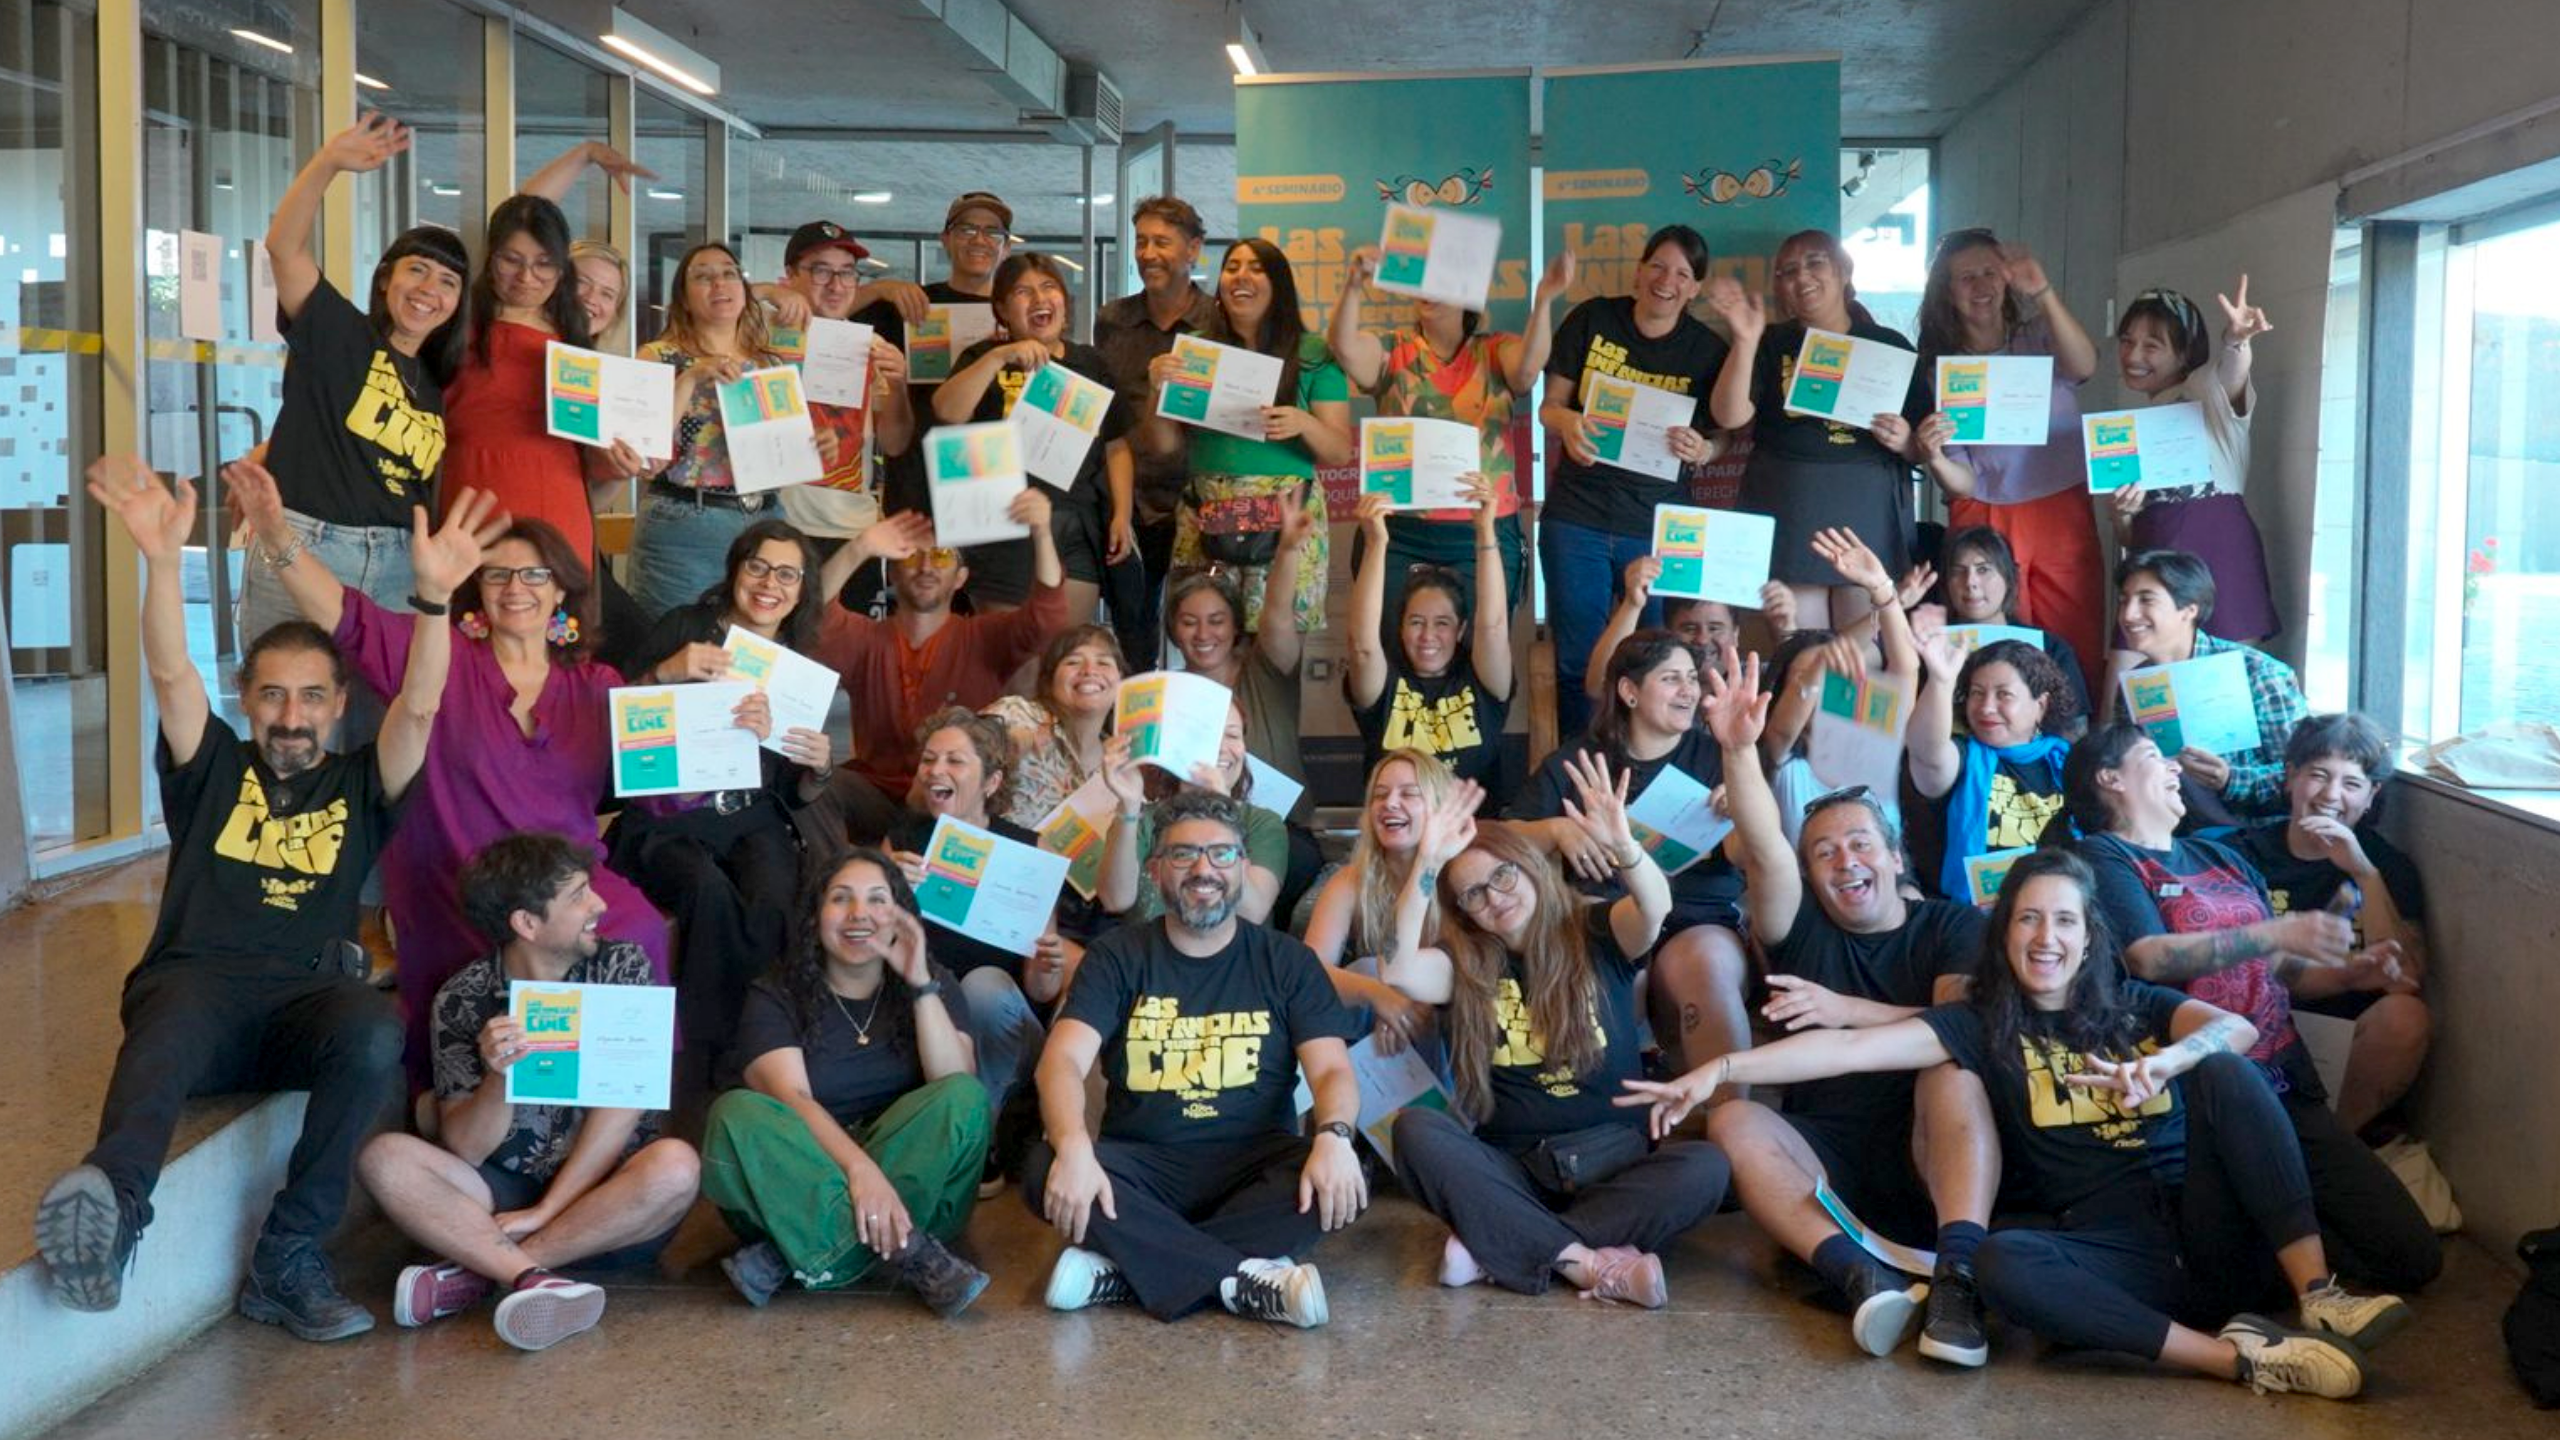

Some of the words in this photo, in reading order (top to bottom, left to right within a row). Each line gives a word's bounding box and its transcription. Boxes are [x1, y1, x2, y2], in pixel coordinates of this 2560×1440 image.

[1267, 181, 1342, 196] SEMINARIO
[525, 1014, 571, 1033] CINE
[1126, 1010, 1270, 1040] INFANCIAS
[1126, 1036, 1262, 1092] CINE
